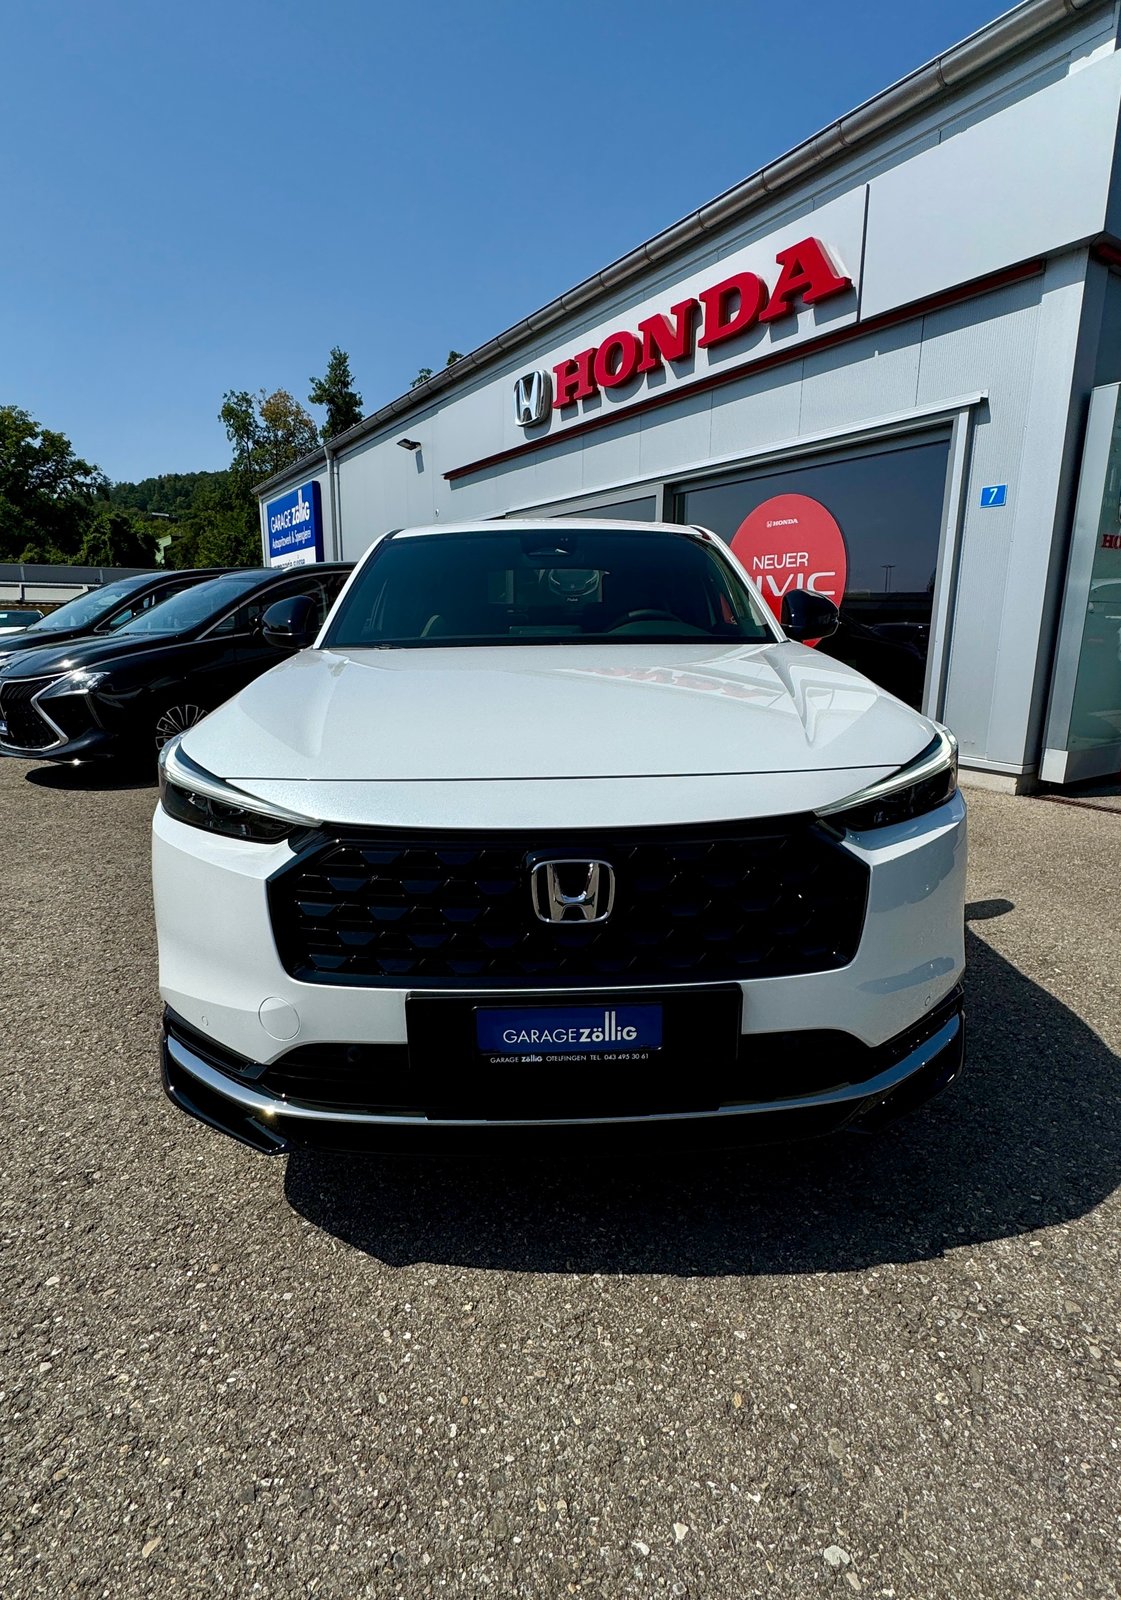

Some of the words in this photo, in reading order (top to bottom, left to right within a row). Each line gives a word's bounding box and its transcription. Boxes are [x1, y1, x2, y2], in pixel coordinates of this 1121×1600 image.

[553, 237, 852, 408] HONDA
[988, 487, 998, 504] 7
[271, 509, 291, 533] GARAGE
[773, 518, 799, 527] HONDA
[752, 551, 809, 570] NEUER
[749, 571, 836, 597] IVIC
[503, 1028, 577, 1044] GARAGE
[490, 1056, 520, 1064] GARAGE
[546, 1054, 587, 1062] OTELFINGEN
[604, 1053, 617, 1061] 043
